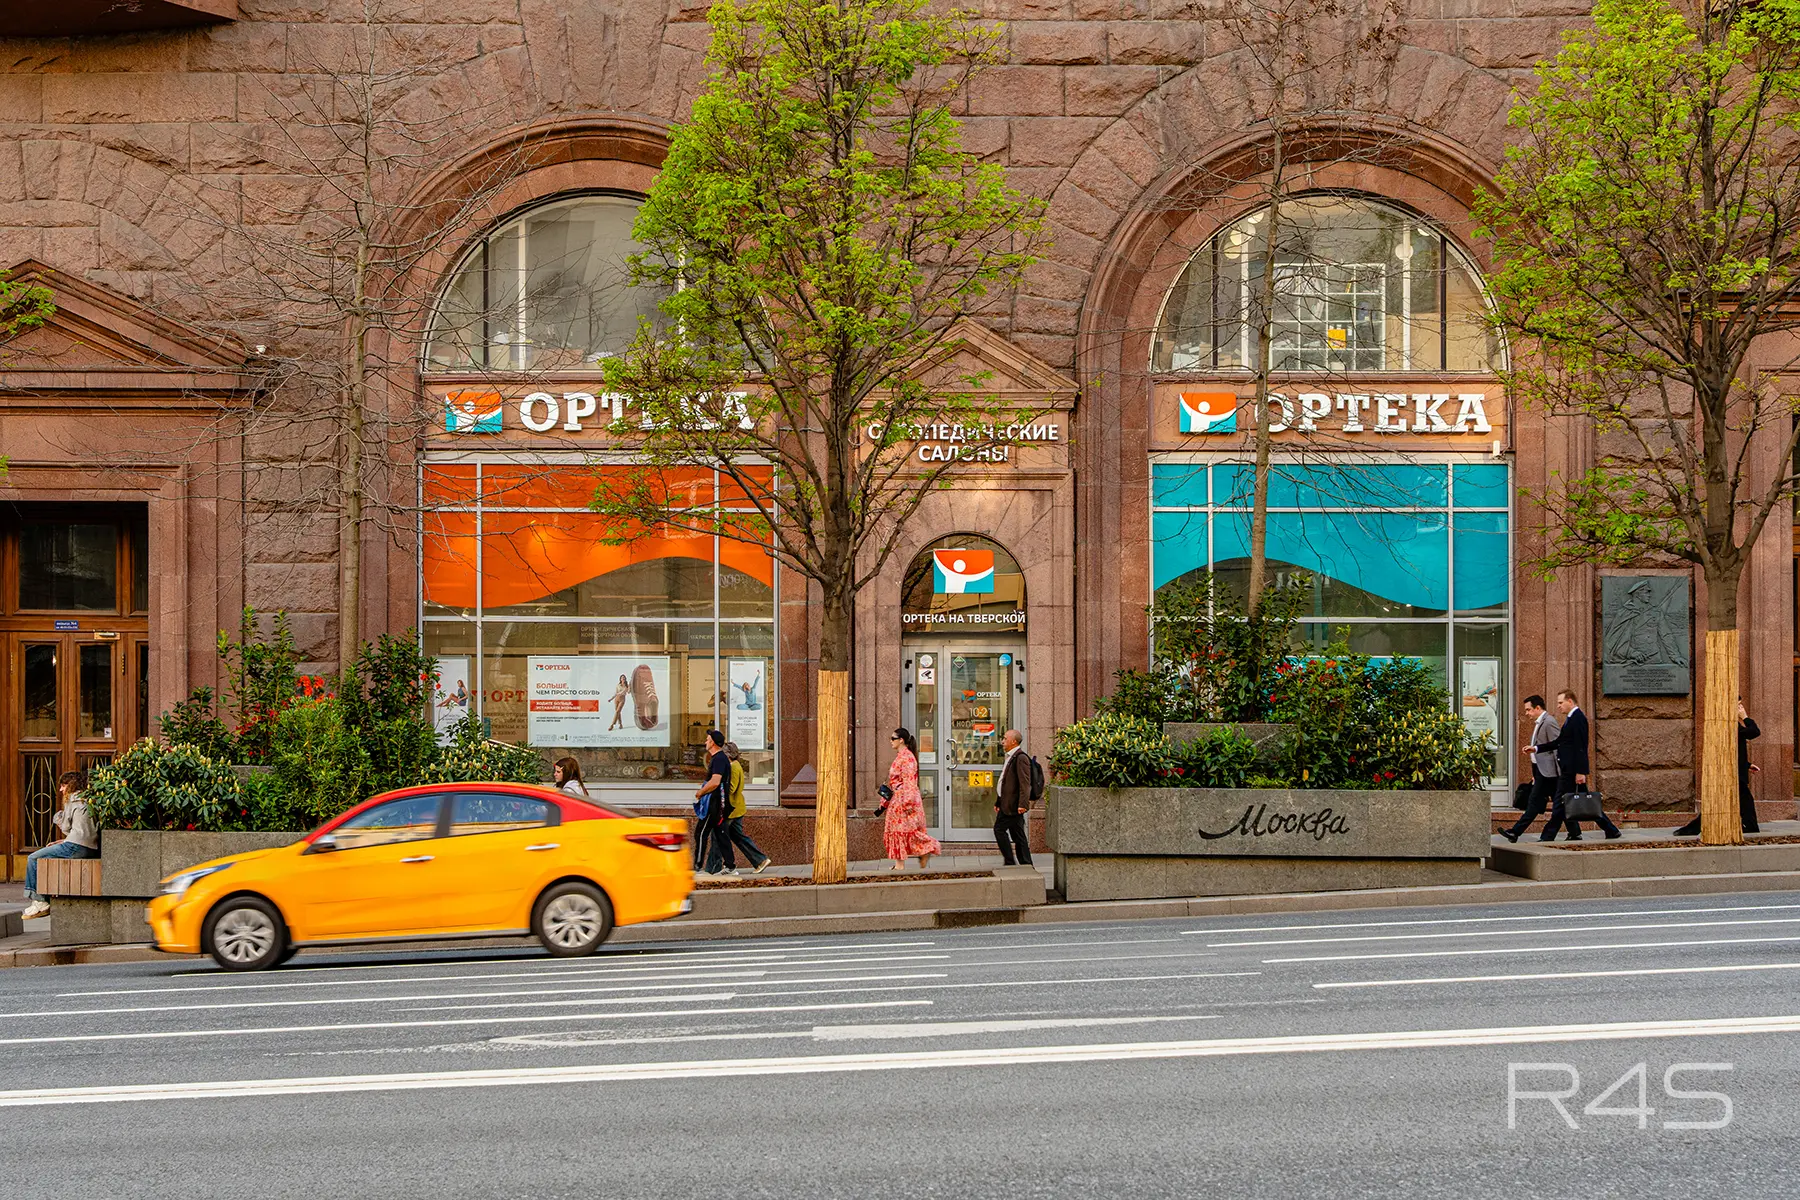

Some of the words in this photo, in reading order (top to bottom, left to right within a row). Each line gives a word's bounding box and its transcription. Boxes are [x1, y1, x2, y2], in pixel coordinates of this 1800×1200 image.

[1254, 393, 1493, 433] ОРТЕКА
[867, 423, 1059, 443] ООПЕДИЧЕСКИЕ
[902, 613, 947, 624] ОРТЕКА
[948, 613, 965, 623] НА
[967, 611, 1026, 624] ТВЕРСКОЙ
[491, 690, 528, 703] ОРТ
[1199, 804, 1350, 841] Москва
